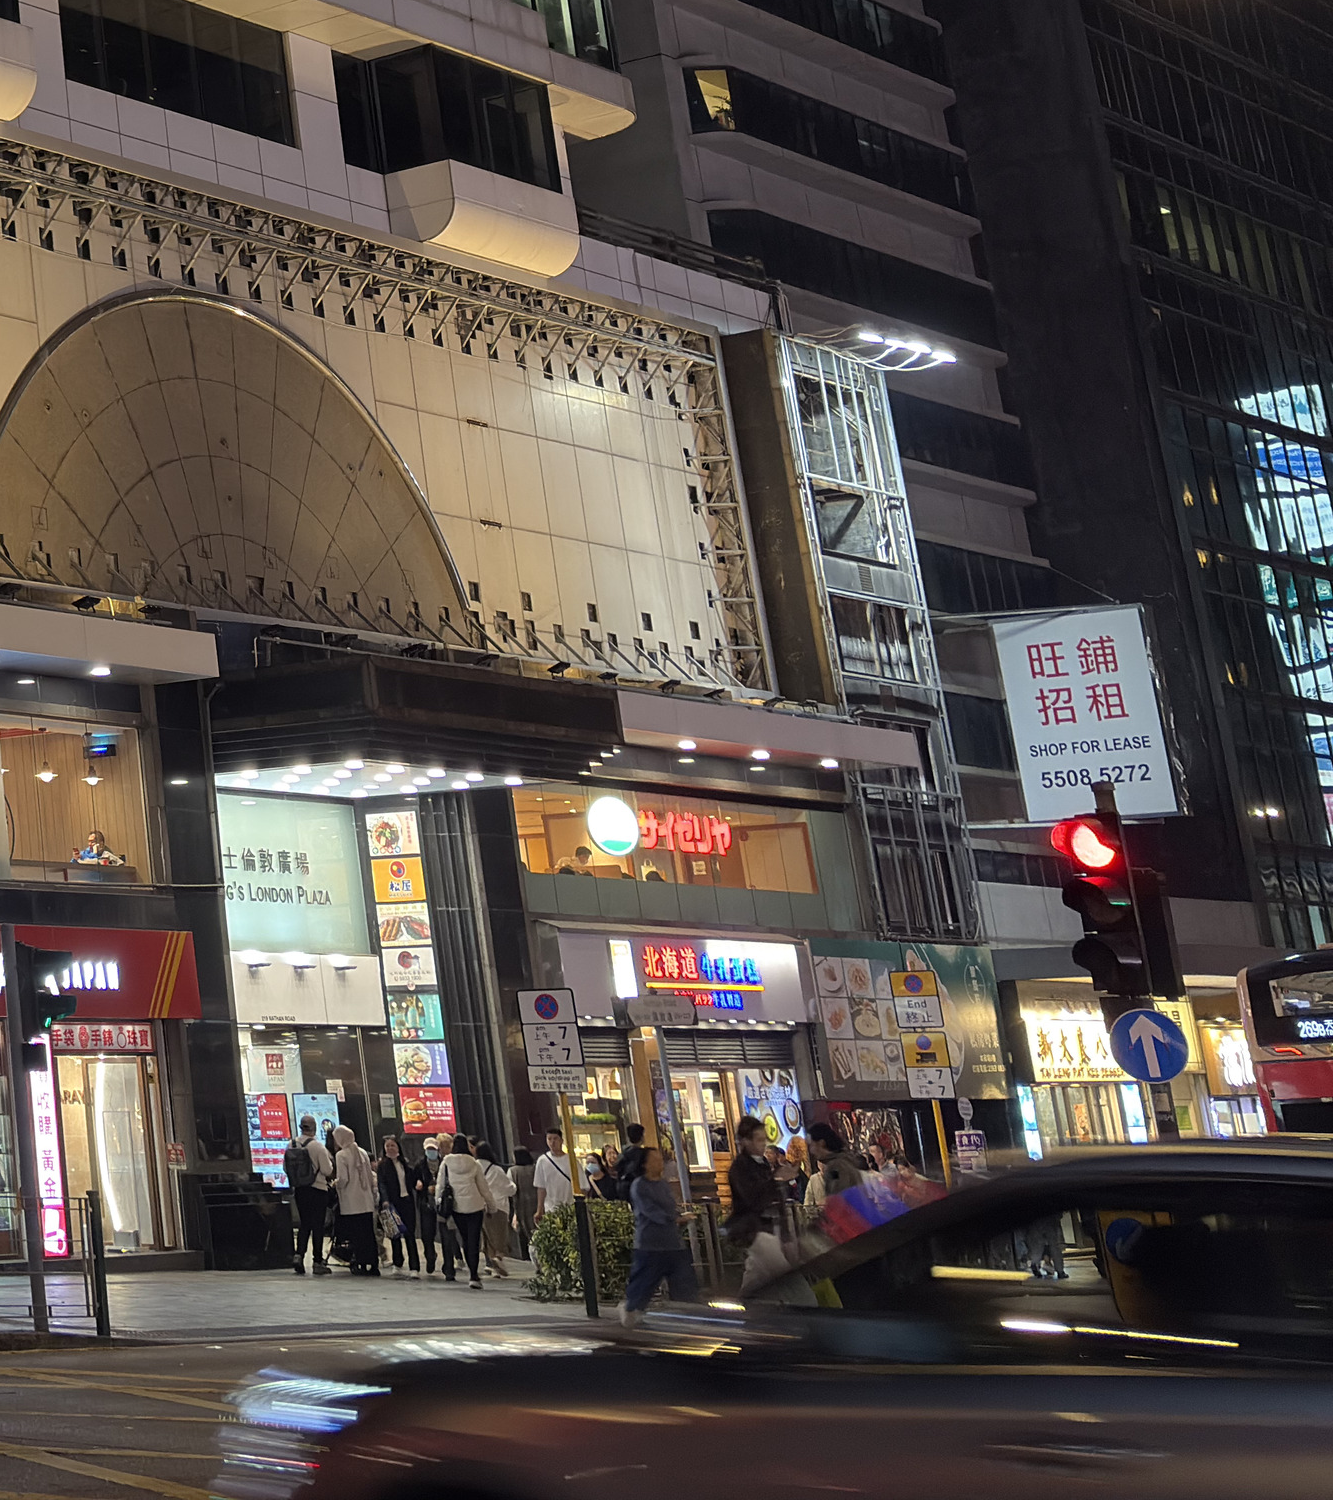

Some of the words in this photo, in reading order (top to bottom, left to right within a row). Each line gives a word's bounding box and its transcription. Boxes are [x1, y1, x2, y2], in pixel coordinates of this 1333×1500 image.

[1026, 635, 1119, 679] 旺鋪
[1035, 683, 1130, 726] 招租
[1029, 742, 1068, 758] SHOP
[1072, 739, 1102, 755] FOR
[1104, 735, 1151, 752] LEASE
[1041, 768, 1092, 789] 5508
[1099, 763, 1152, 784] 5272
[638, 810, 732, 856] サイゼリヤ
[248, 883, 294, 904] LONDON
[297, 885, 332, 906] PLAZA
[389, 880, 412, 892] 松屋
[643, 945, 699, 981] 北海道
[62, 960, 121, 992] JAPAN
[907, 1000, 927, 1009] End
[905, 1011, 934, 1023] 終止
[51, 1029, 75, 1047] 手袋
[91, 1029, 114, 1046] 手錶
[127, 1029, 149, 1047] 珠寶
[535, 1032, 551, 1040] 上午
[558, 1026, 567, 1039] 7
[1297, 1020, 1327, 1039] 269B
[537, 1053, 554, 1062] 下午
[562, 1048, 571, 1061] 7
[541, 1068, 561, 1076] Except
[935, 1069, 943, 1080] 7
[937, 1085, 945, 1096] 7
